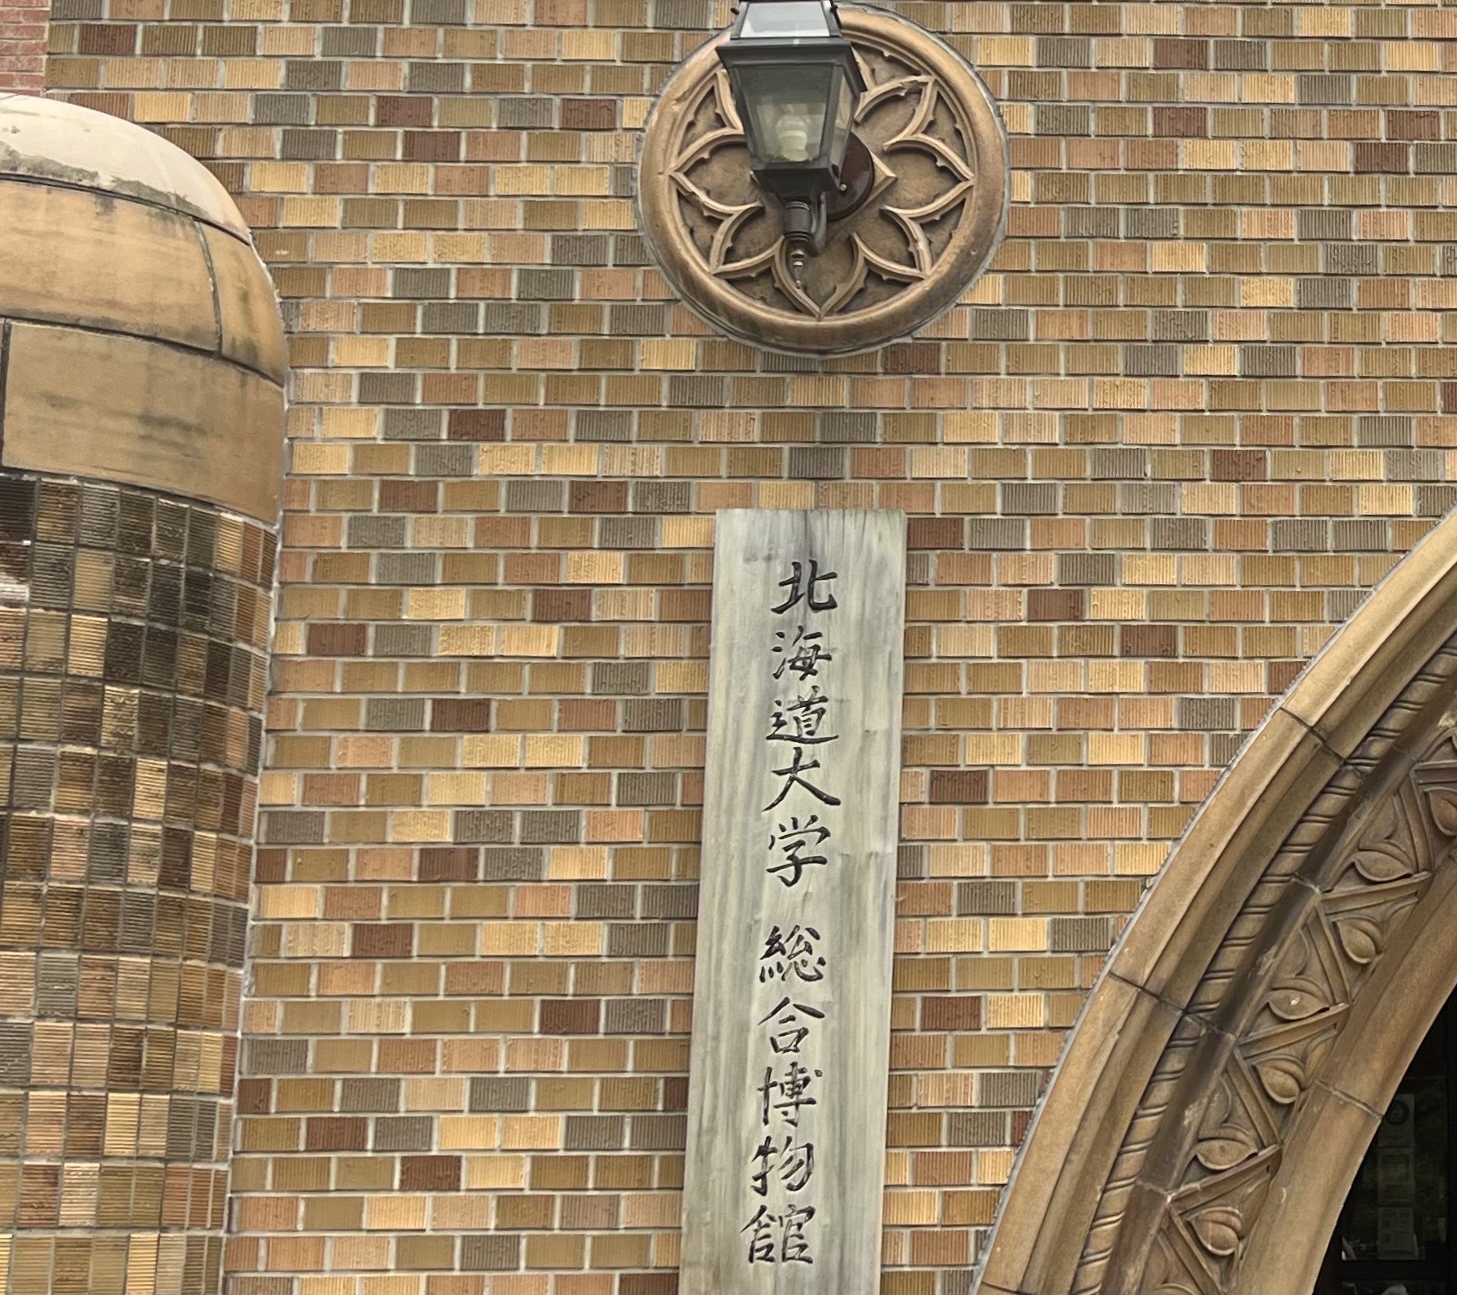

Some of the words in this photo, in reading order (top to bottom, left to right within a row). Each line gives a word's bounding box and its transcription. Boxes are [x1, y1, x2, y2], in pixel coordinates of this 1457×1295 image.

[761, 558, 840, 890] 北海道大学
[740, 924, 826, 1267] 総合博物館
